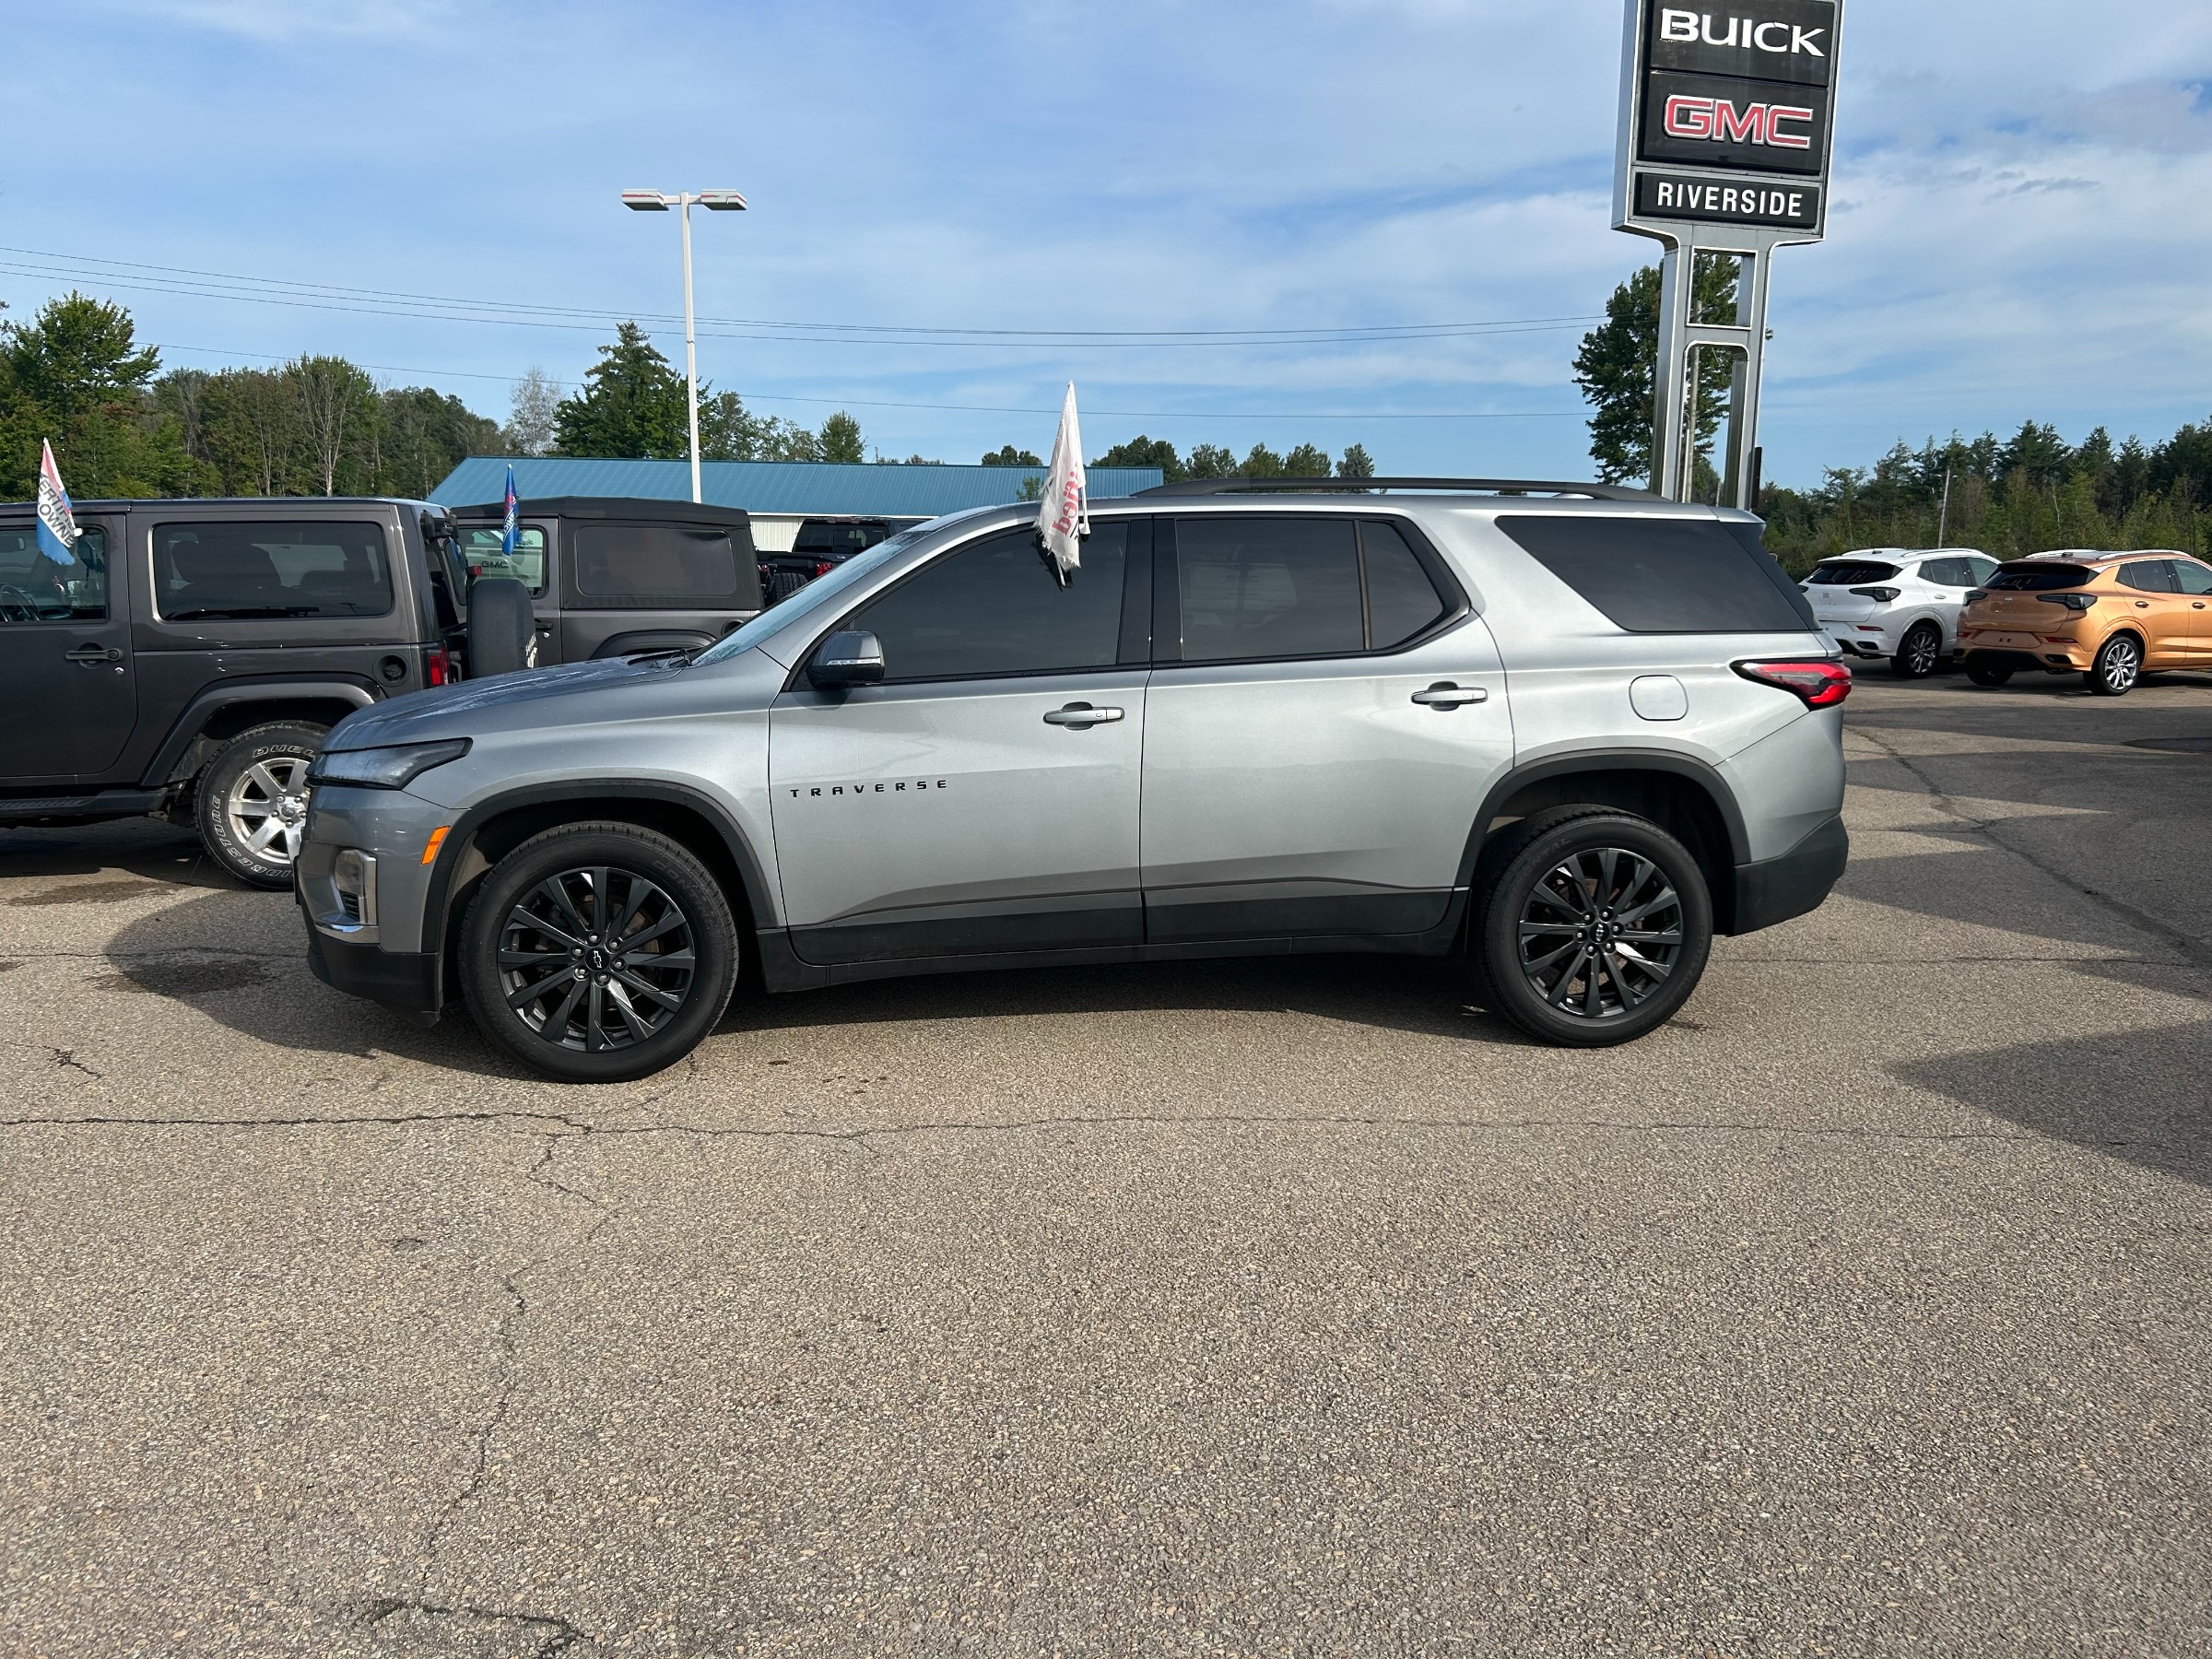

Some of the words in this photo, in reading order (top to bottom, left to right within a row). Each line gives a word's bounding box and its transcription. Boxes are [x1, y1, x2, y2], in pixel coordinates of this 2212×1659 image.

[1660, 7, 1826, 58] BUICK
[1663, 93, 1814, 149] GMC
[1657, 182, 1803, 218] RIVERSIDE
[482, 560, 510, 569] GMC
[253, 745, 316, 760] DUEL
[790, 780, 947, 798] TRAVERSE
[211, 794, 294, 877] IDGESTONE
